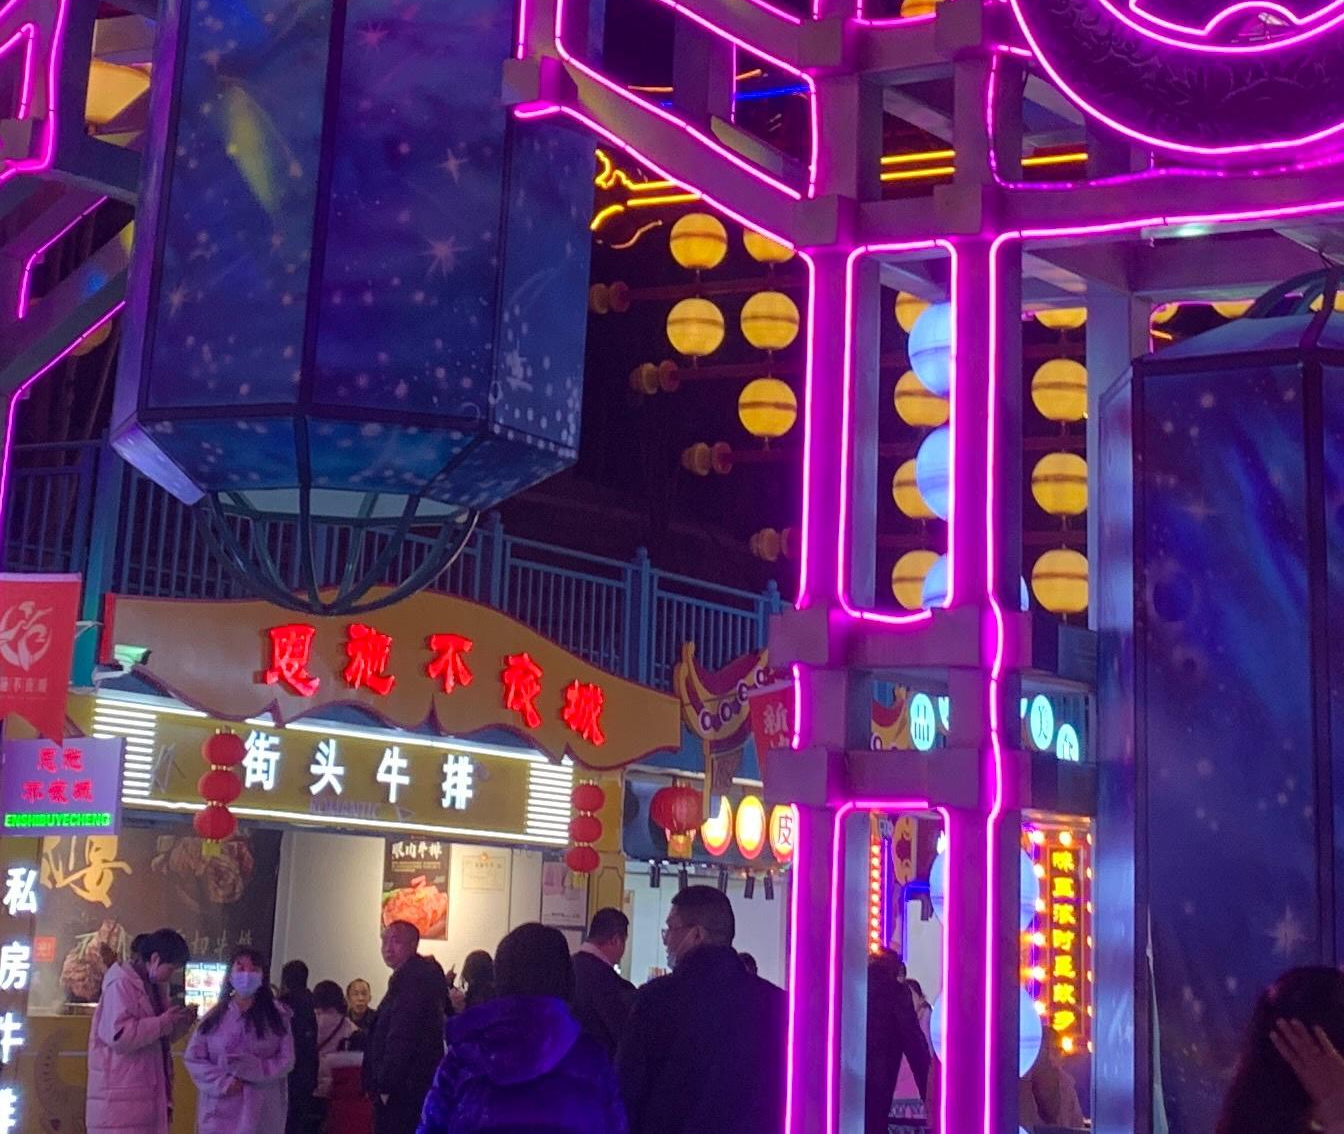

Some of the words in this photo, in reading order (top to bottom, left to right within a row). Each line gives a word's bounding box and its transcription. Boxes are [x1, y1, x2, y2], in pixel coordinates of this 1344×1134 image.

[263, 623, 605, 746] 恩施不夜城
[242, 729, 474, 810] 街头牛排
